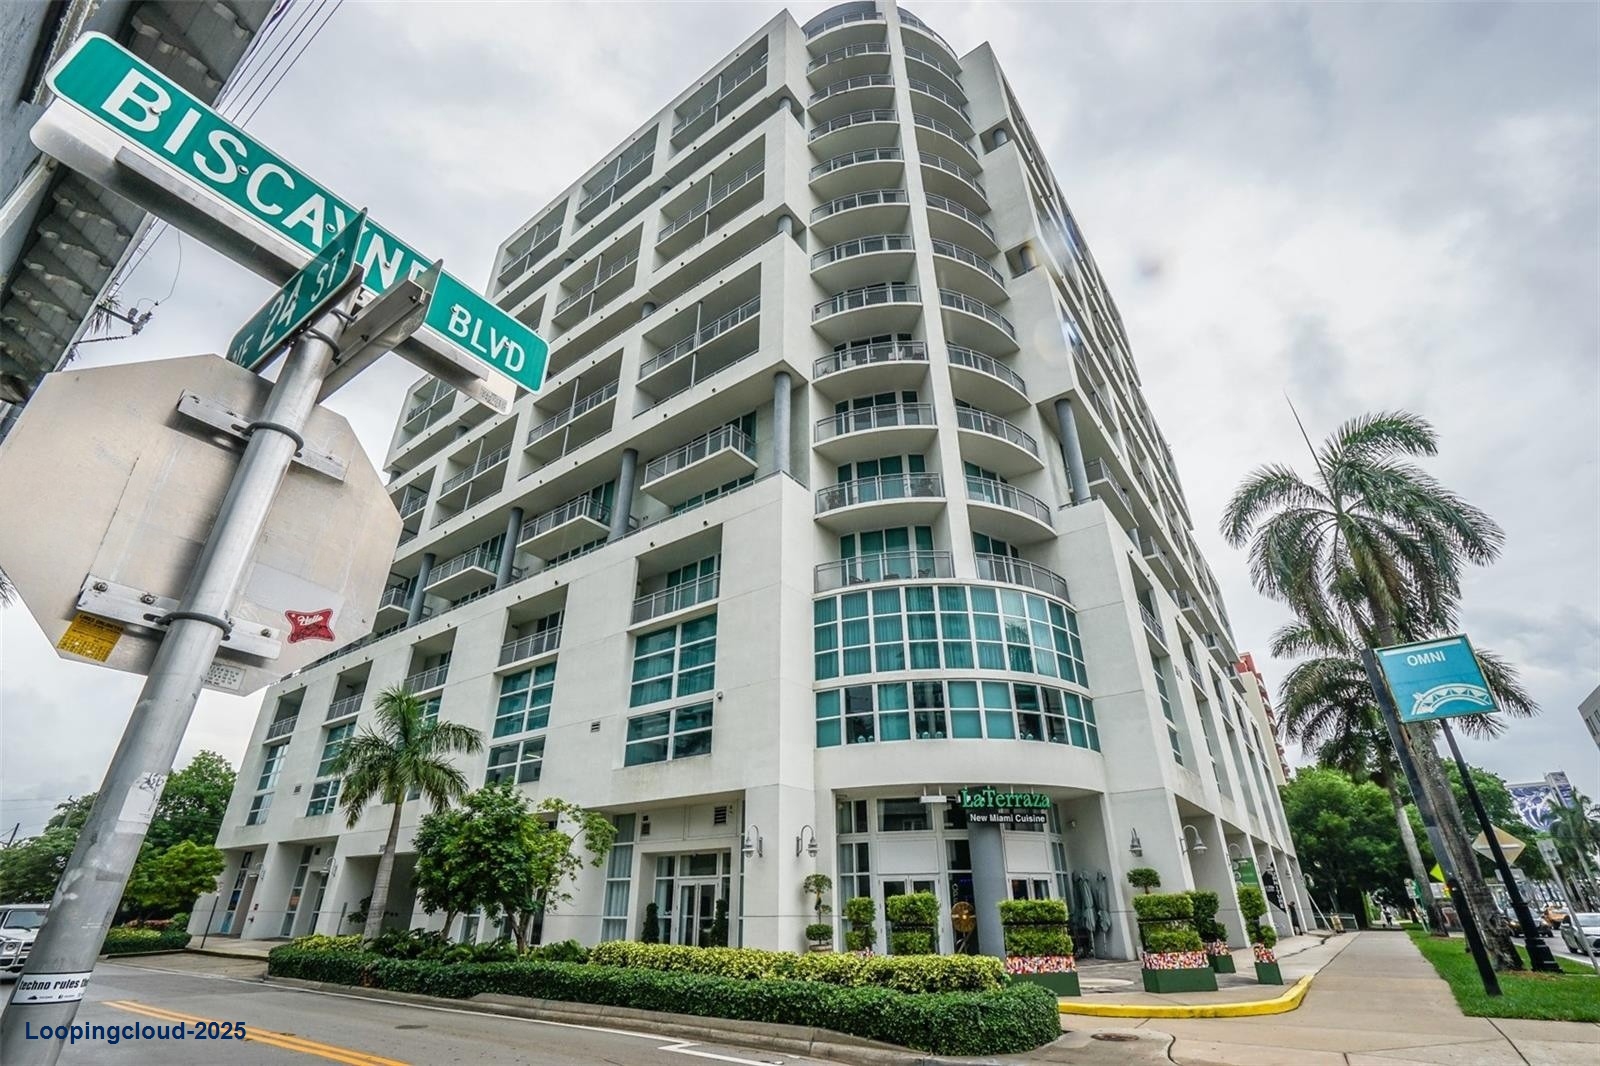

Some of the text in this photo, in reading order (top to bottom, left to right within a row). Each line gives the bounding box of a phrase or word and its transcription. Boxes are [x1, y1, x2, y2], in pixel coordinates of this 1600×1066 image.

[258, 274, 304, 352] 24
[311, 247, 345, 302] ST
[448, 303, 525, 372] BLVD
[1406, 650, 1446, 666] OMNI
[970, 813, 1046, 823] New Miami Cuisine
[19, 980, 52, 991] techno
[53, 978, 80, 990] rules
